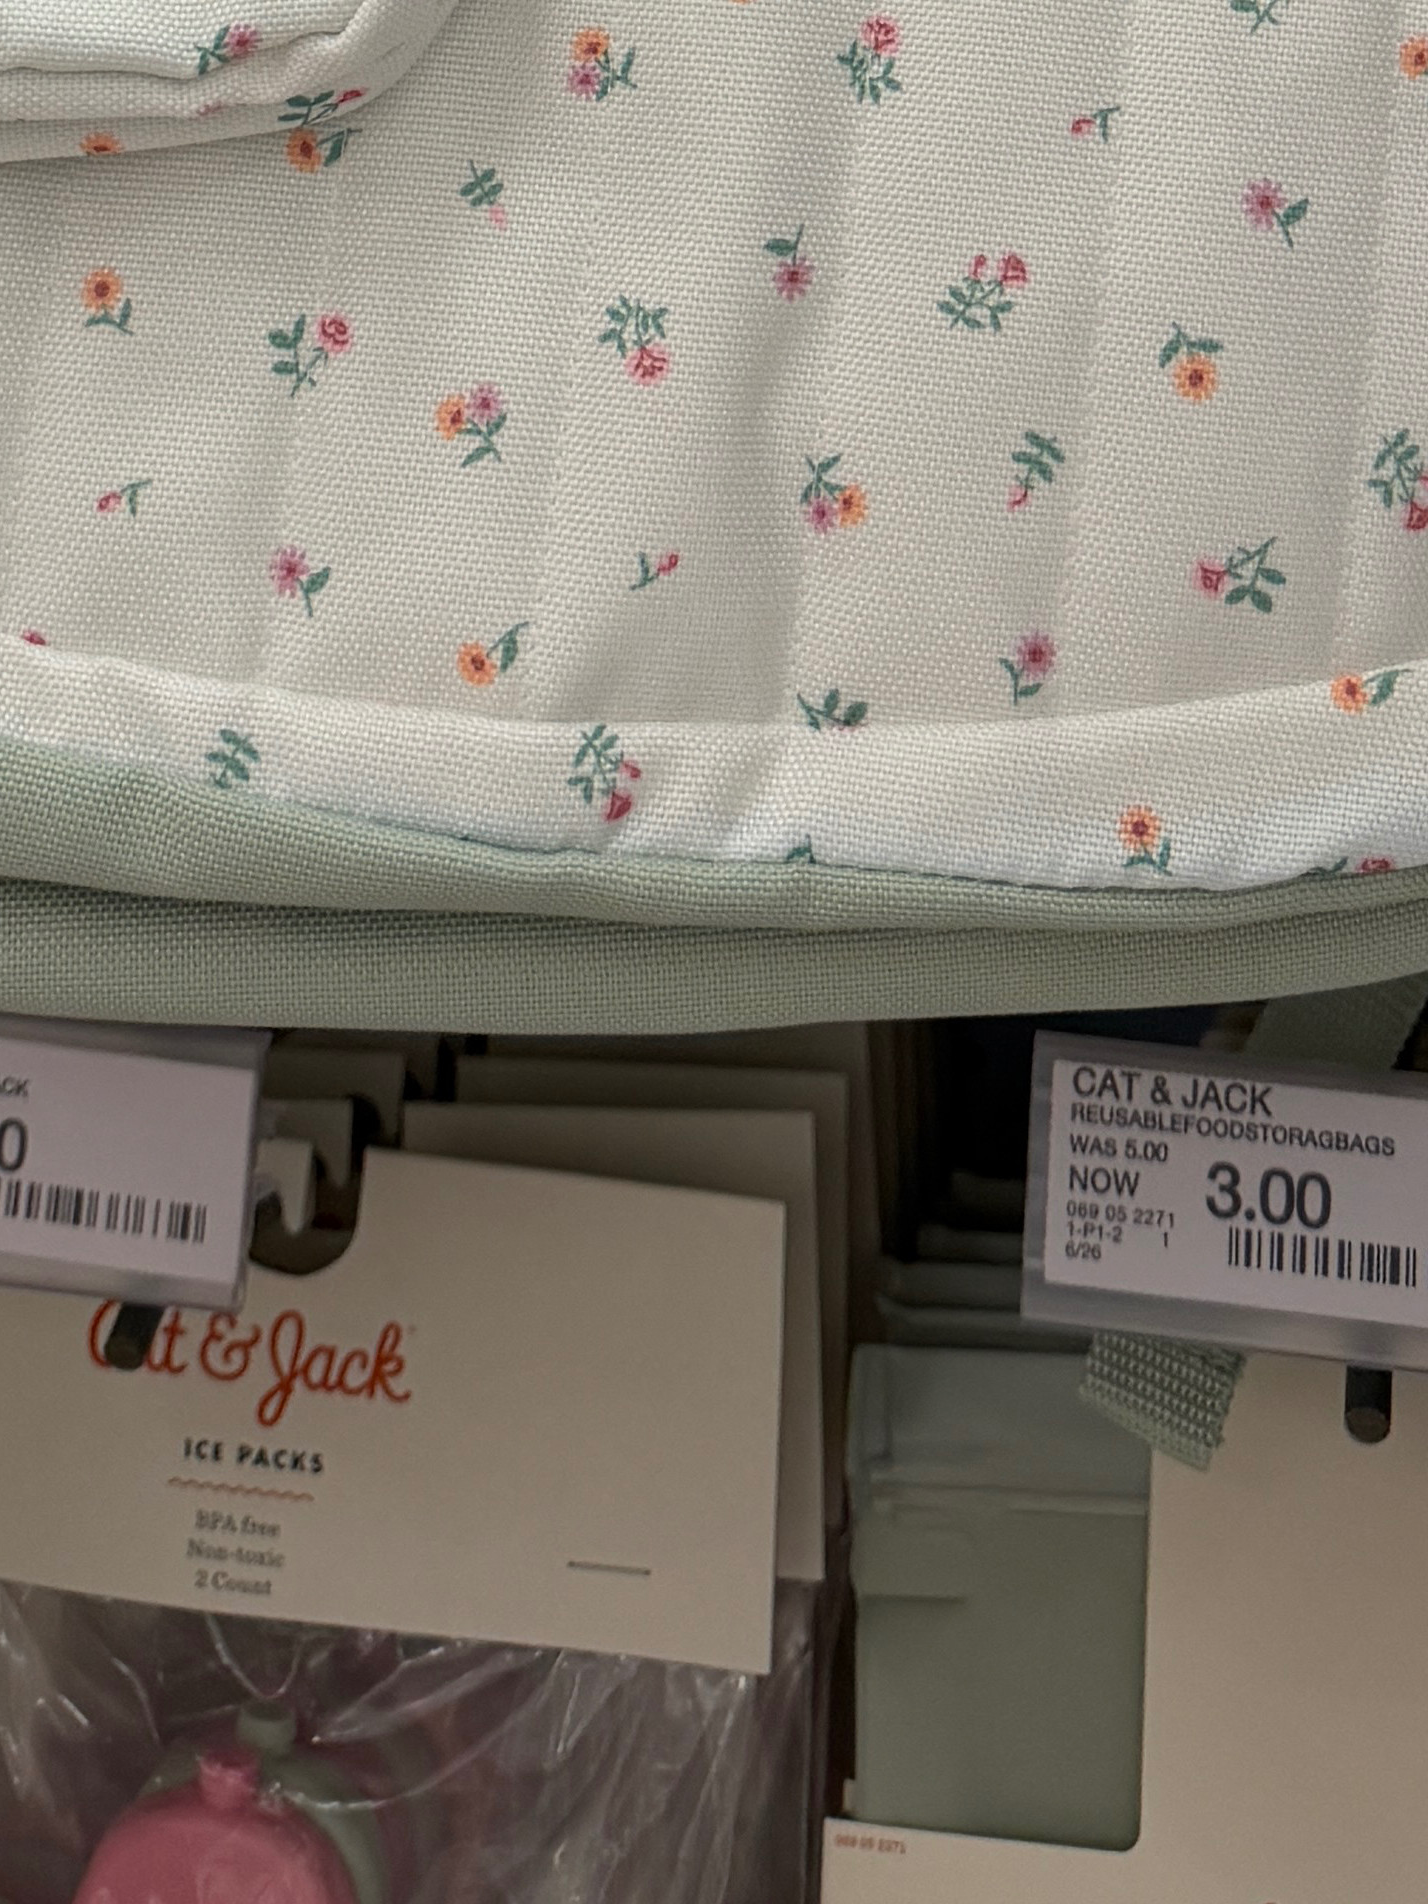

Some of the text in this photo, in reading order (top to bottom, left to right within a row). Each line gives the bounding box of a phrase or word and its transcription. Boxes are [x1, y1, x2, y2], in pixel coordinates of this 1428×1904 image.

[1073, 1066, 1273, 1116] CAT & JACK
[1071, 1102, 1396, 1156] REUSABLEFOODSTORAGBAGS
[1070, 1133, 1168, 1163] WAS 5.00
[1068, 1160, 1332, 1229] NOW 3.00
[1066, 1200, 1175, 1228] 069 05 2271
[1067, 1223, 1122, 1243] 1-P1-2
[1065, 1243, 1102, 1261] 6/26
[199, 1311, 262, 1381] &
[255, 1308, 412, 1428] Jack
[183, 1438, 325, 1475] ICE PACKS
[194, 1508, 238, 1534] BPA
[194, 1569, 209, 1590] 2
